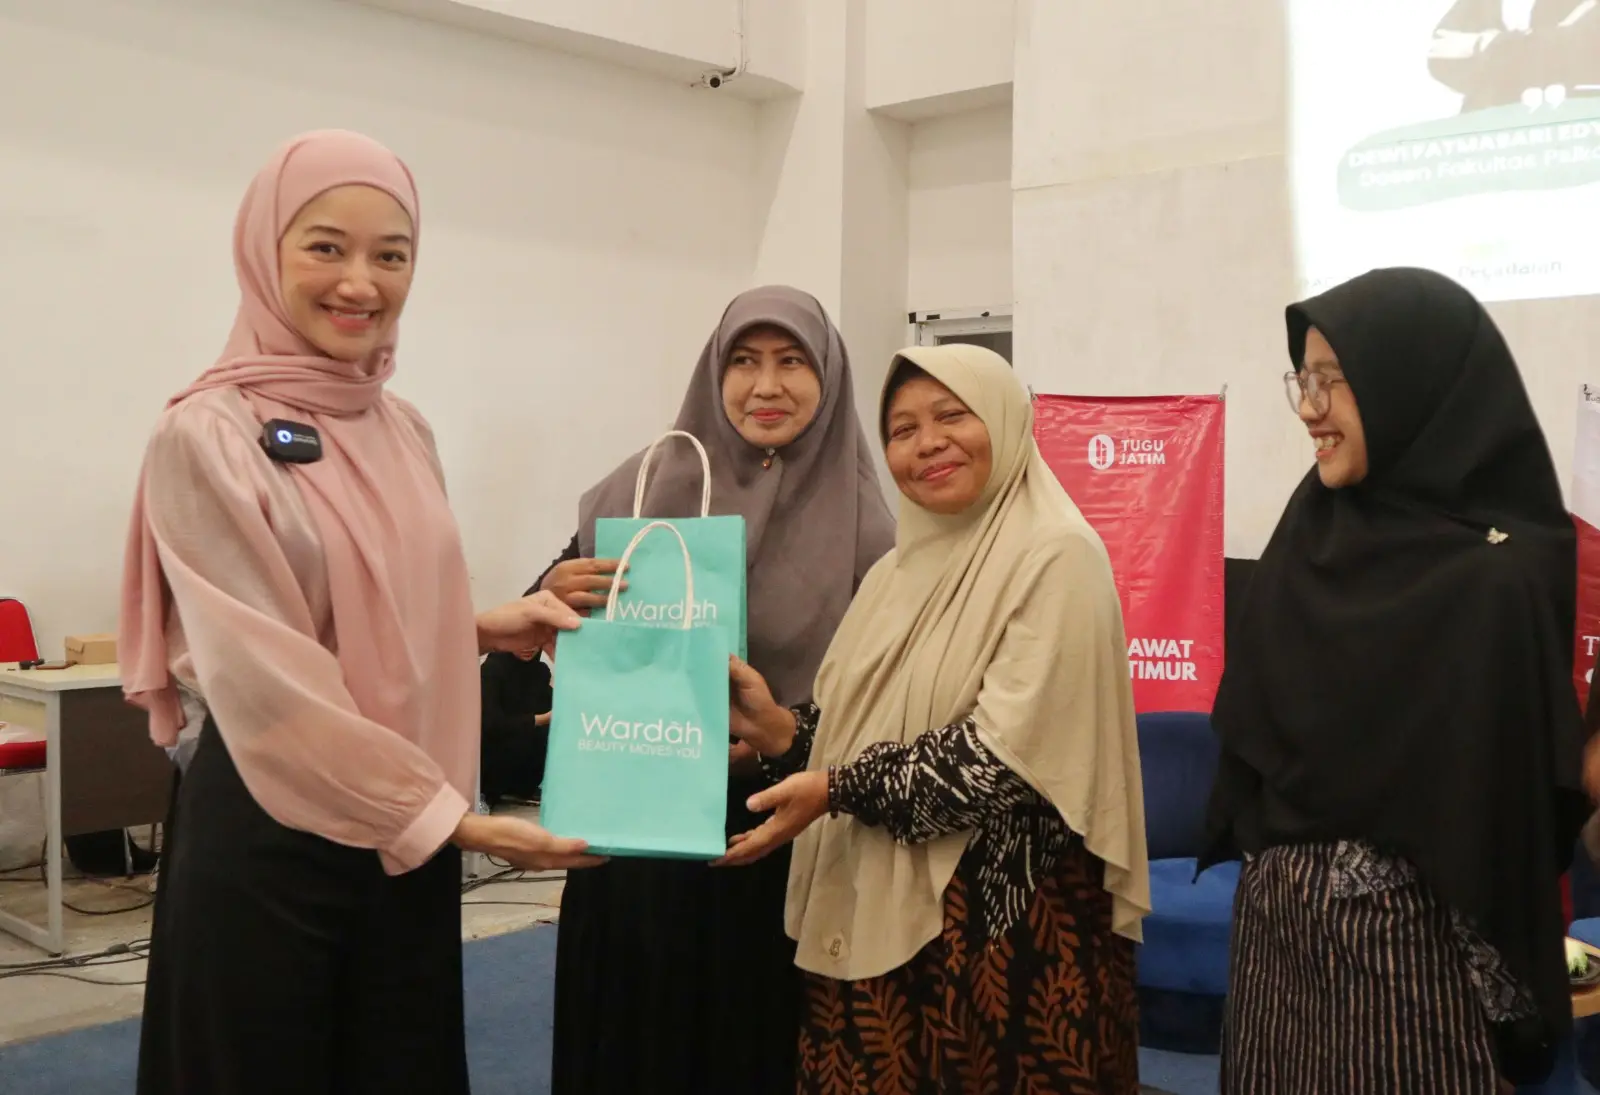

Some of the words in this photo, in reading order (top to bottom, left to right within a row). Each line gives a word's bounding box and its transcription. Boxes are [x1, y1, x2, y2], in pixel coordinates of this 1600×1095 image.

[1437, 153, 1537, 180] Fakultas
[1120, 439, 1164, 452] TUGU
[1119, 453, 1166, 465] JATIM
[1128, 638, 1194, 659] AWAT
[1129, 660, 1198, 681] TIMUR
[578, 739, 627, 753] BEAUTY
[630, 743, 673, 757] MOVES
[676, 746, 701, 760] YOU
